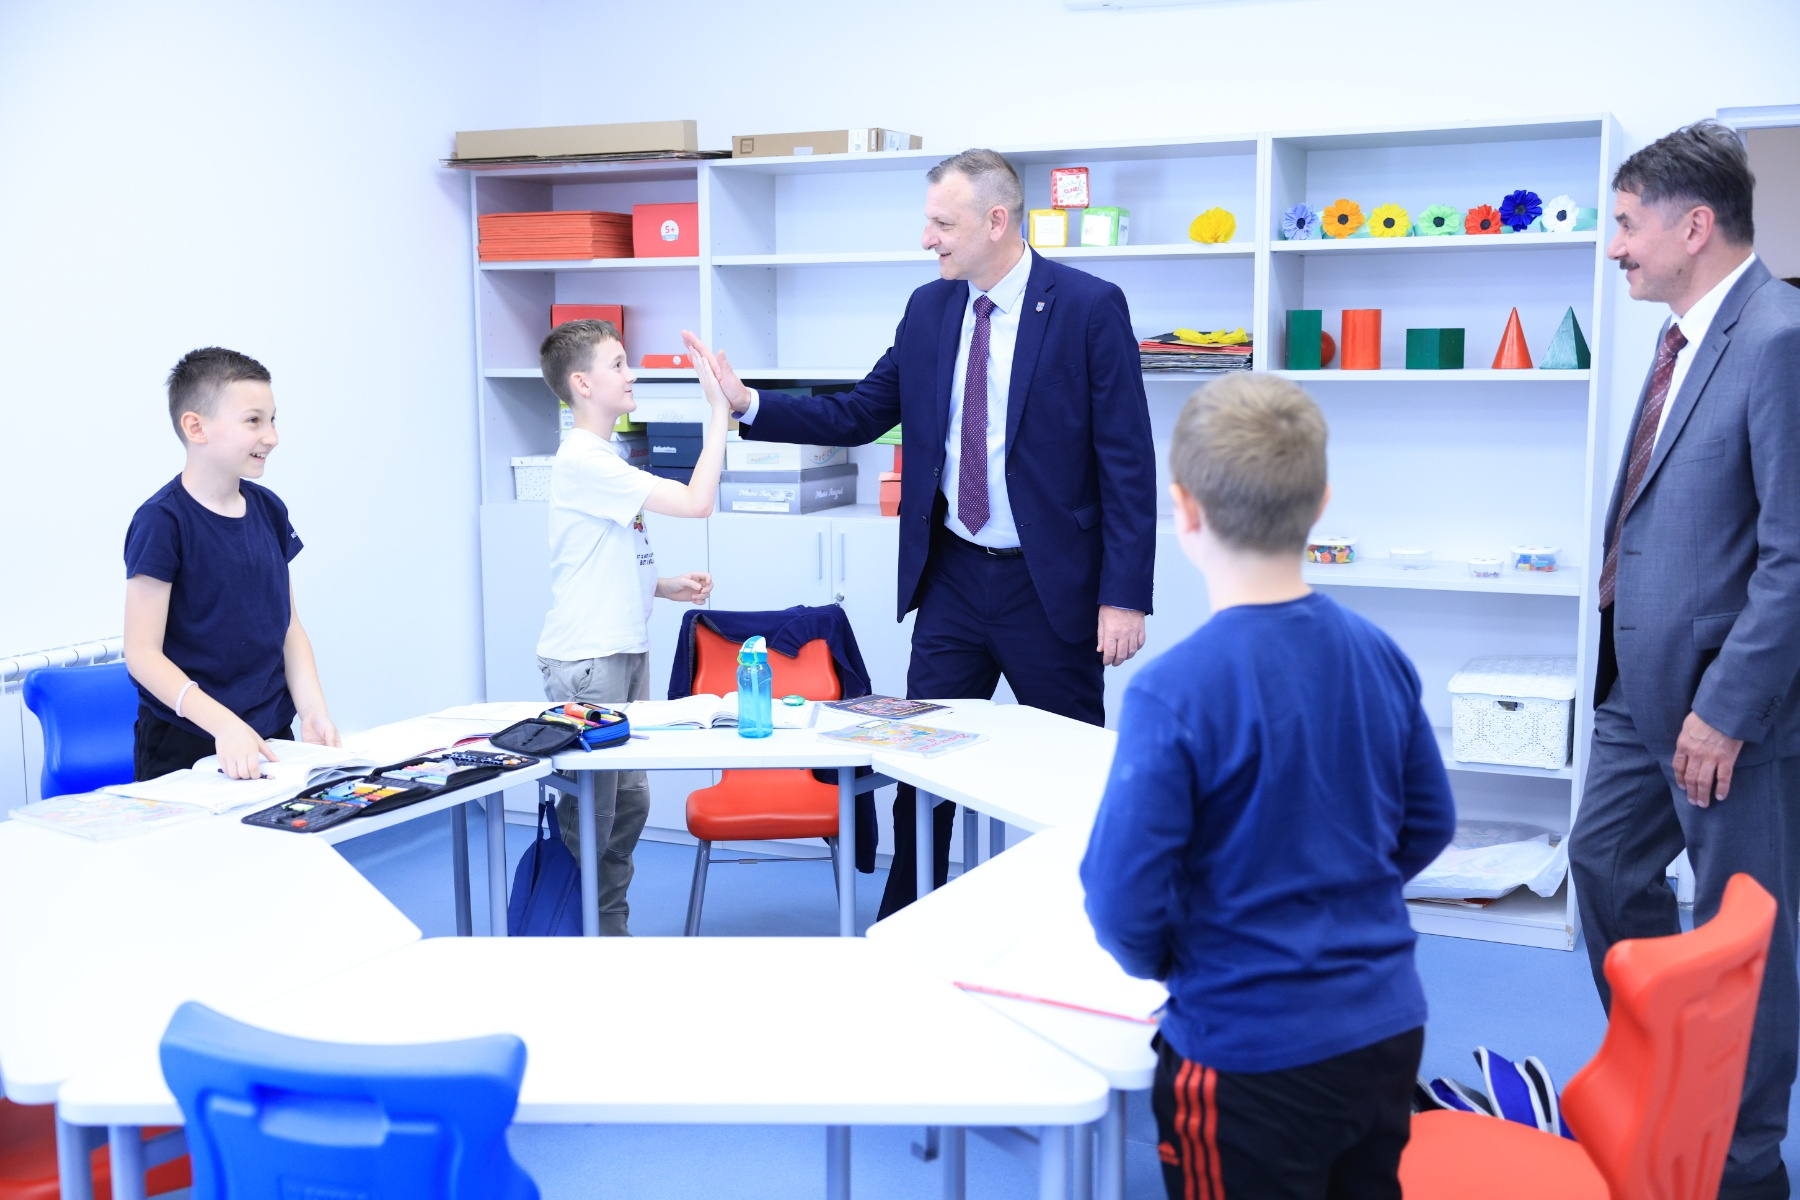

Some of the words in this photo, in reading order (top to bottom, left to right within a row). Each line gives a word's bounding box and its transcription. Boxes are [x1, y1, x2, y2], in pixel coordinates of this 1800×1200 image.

[665, 225, 676, 234] 5+
[739, 488, 757, 497] Miss
[814, 490, 828, 499] Miss
[828, 486, 844, 500] Angel
